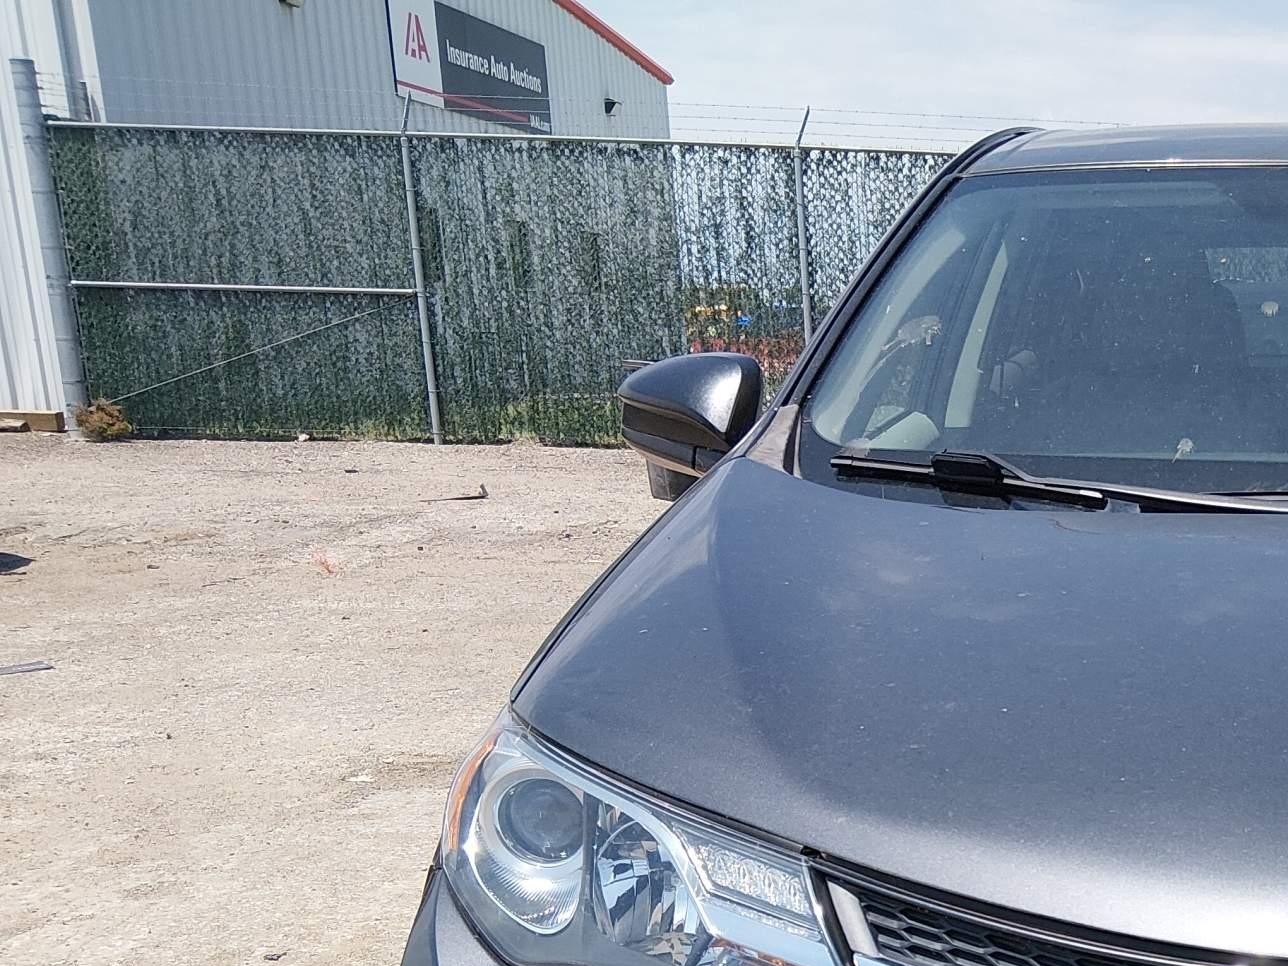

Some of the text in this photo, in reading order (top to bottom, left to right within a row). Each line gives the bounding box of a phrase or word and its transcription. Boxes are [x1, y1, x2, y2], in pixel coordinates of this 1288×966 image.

[445, 39, 542, 94] Insurance Auto Auctions
